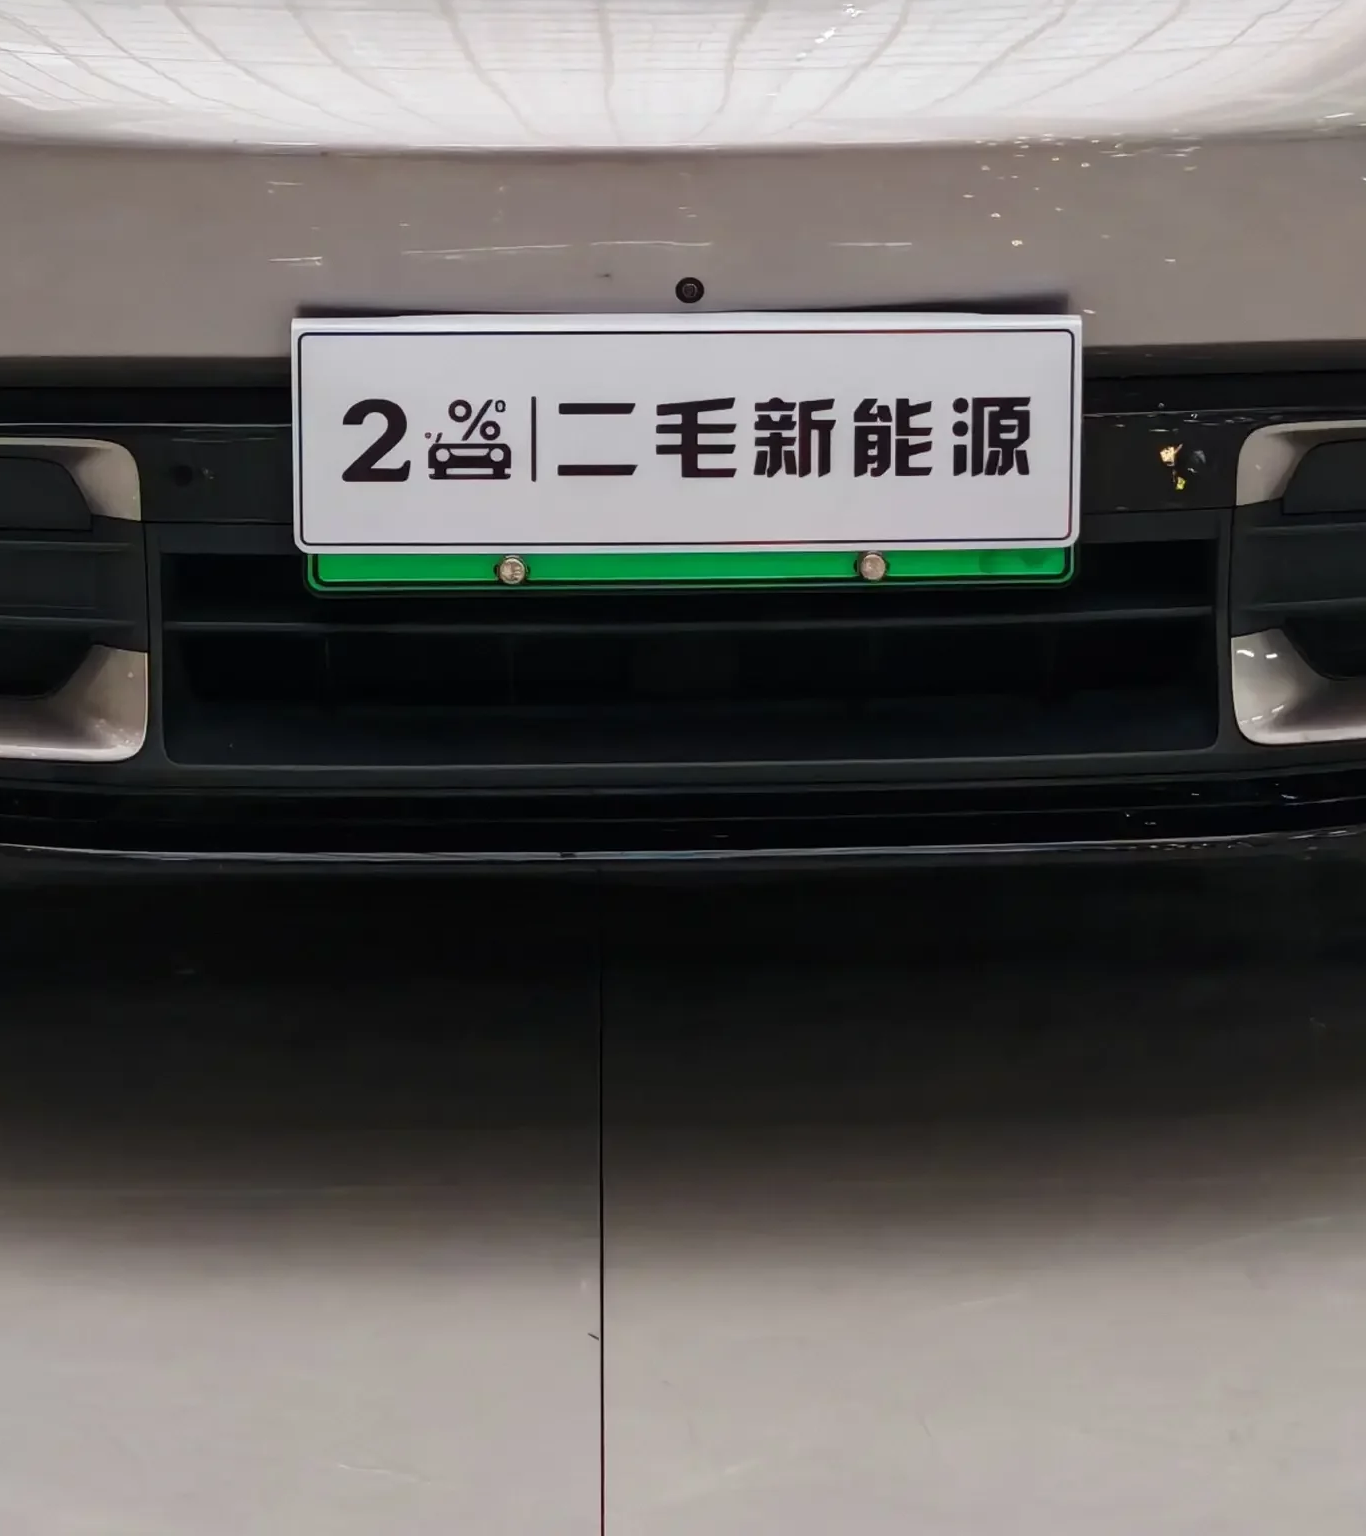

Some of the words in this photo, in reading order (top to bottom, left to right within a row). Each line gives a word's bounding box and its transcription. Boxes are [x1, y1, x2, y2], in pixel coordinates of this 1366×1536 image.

[557, 396, 1032, 478] 二毛新能源
